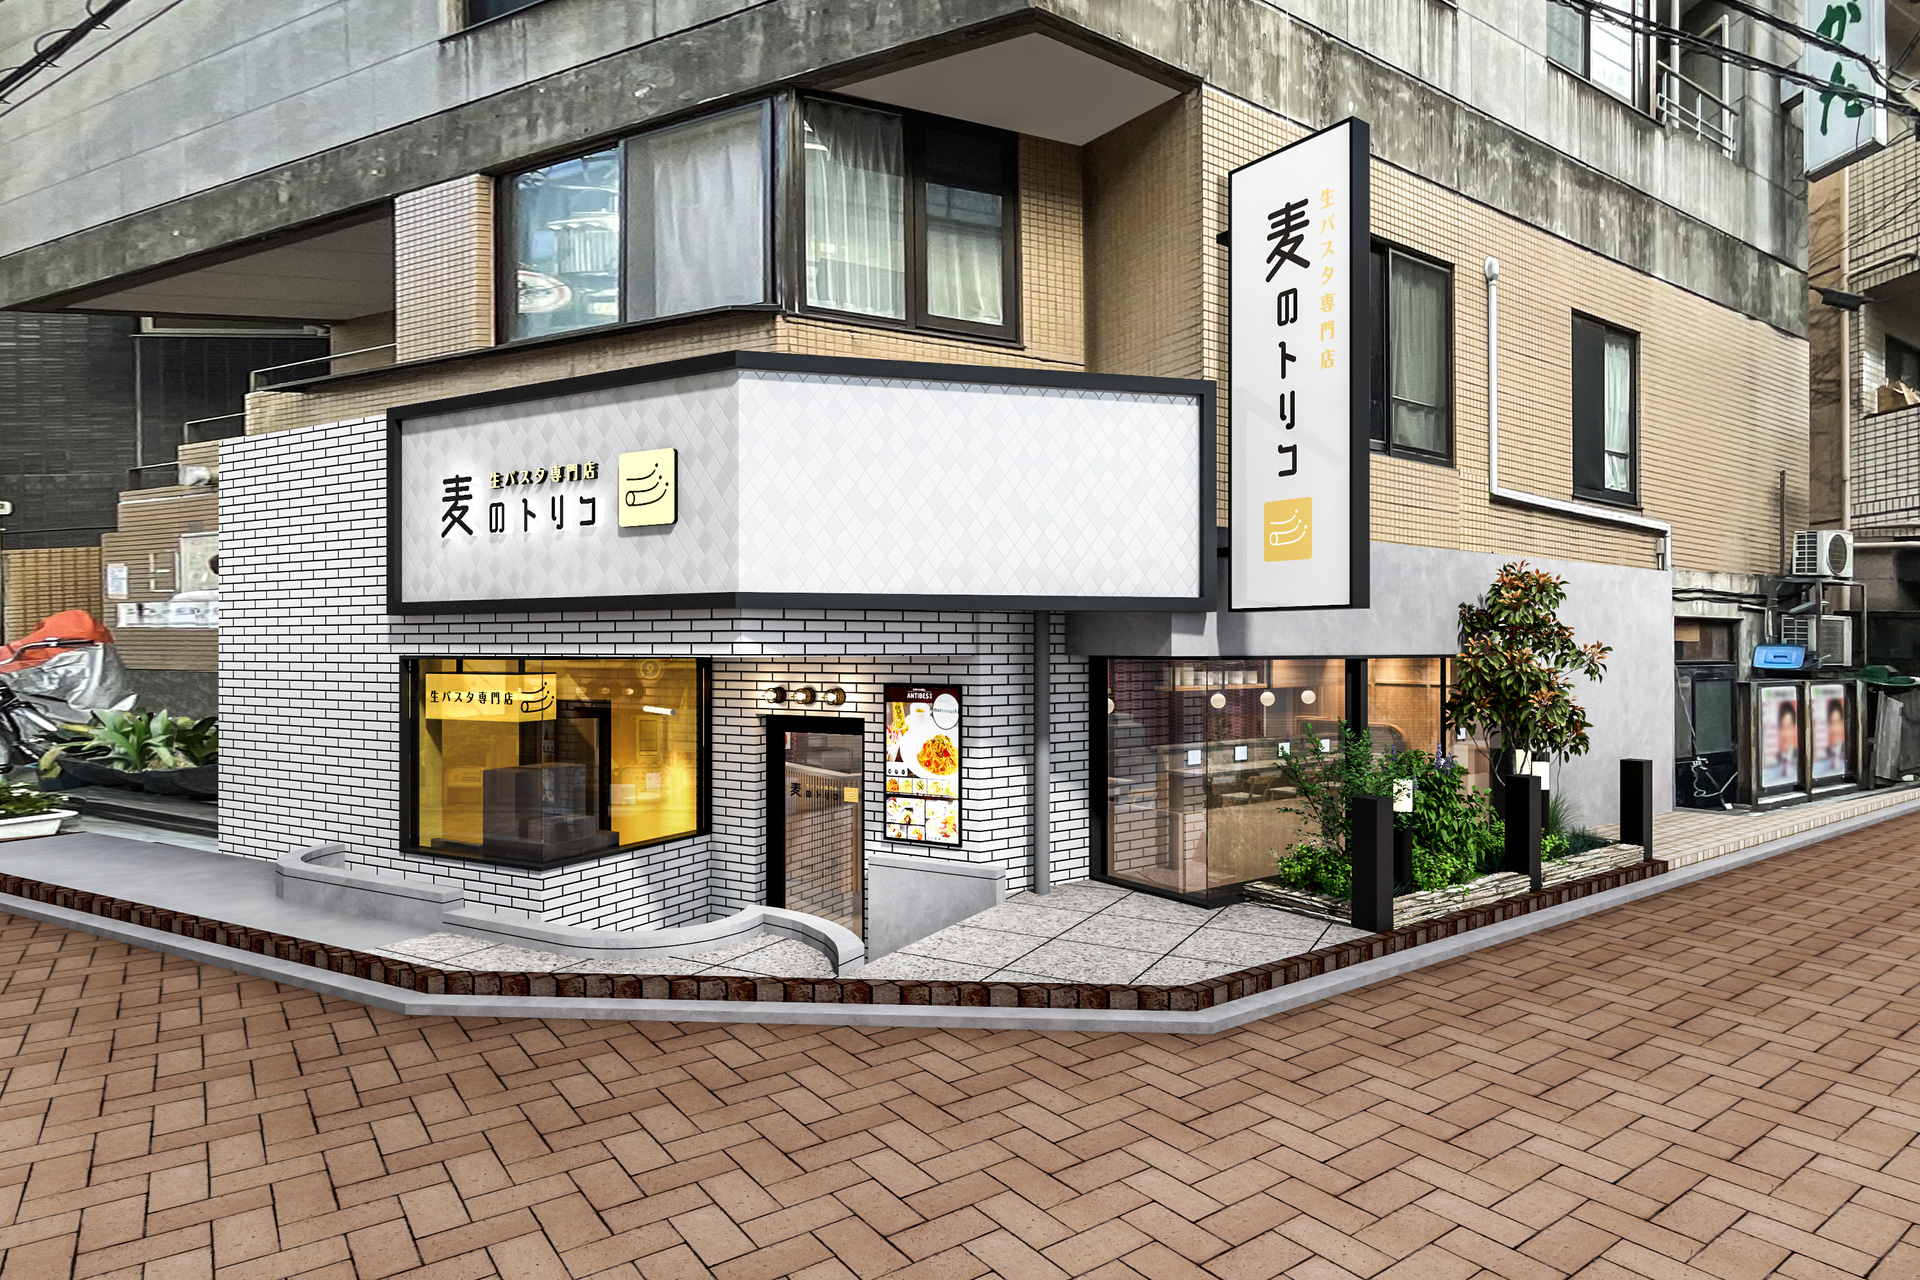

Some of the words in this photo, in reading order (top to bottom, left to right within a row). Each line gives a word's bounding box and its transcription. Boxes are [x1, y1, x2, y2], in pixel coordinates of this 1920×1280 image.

[1320, 187, 1336, 370] 生パスタ専門店
[1265, 197, 1310, 478] 麦のトリコ
[441, 475, 596, 538] 麦のトリコ
[489, 462, 599, 489] 生パスタ専門店
[430, 690, 514, 705] 生パスタ専門店
